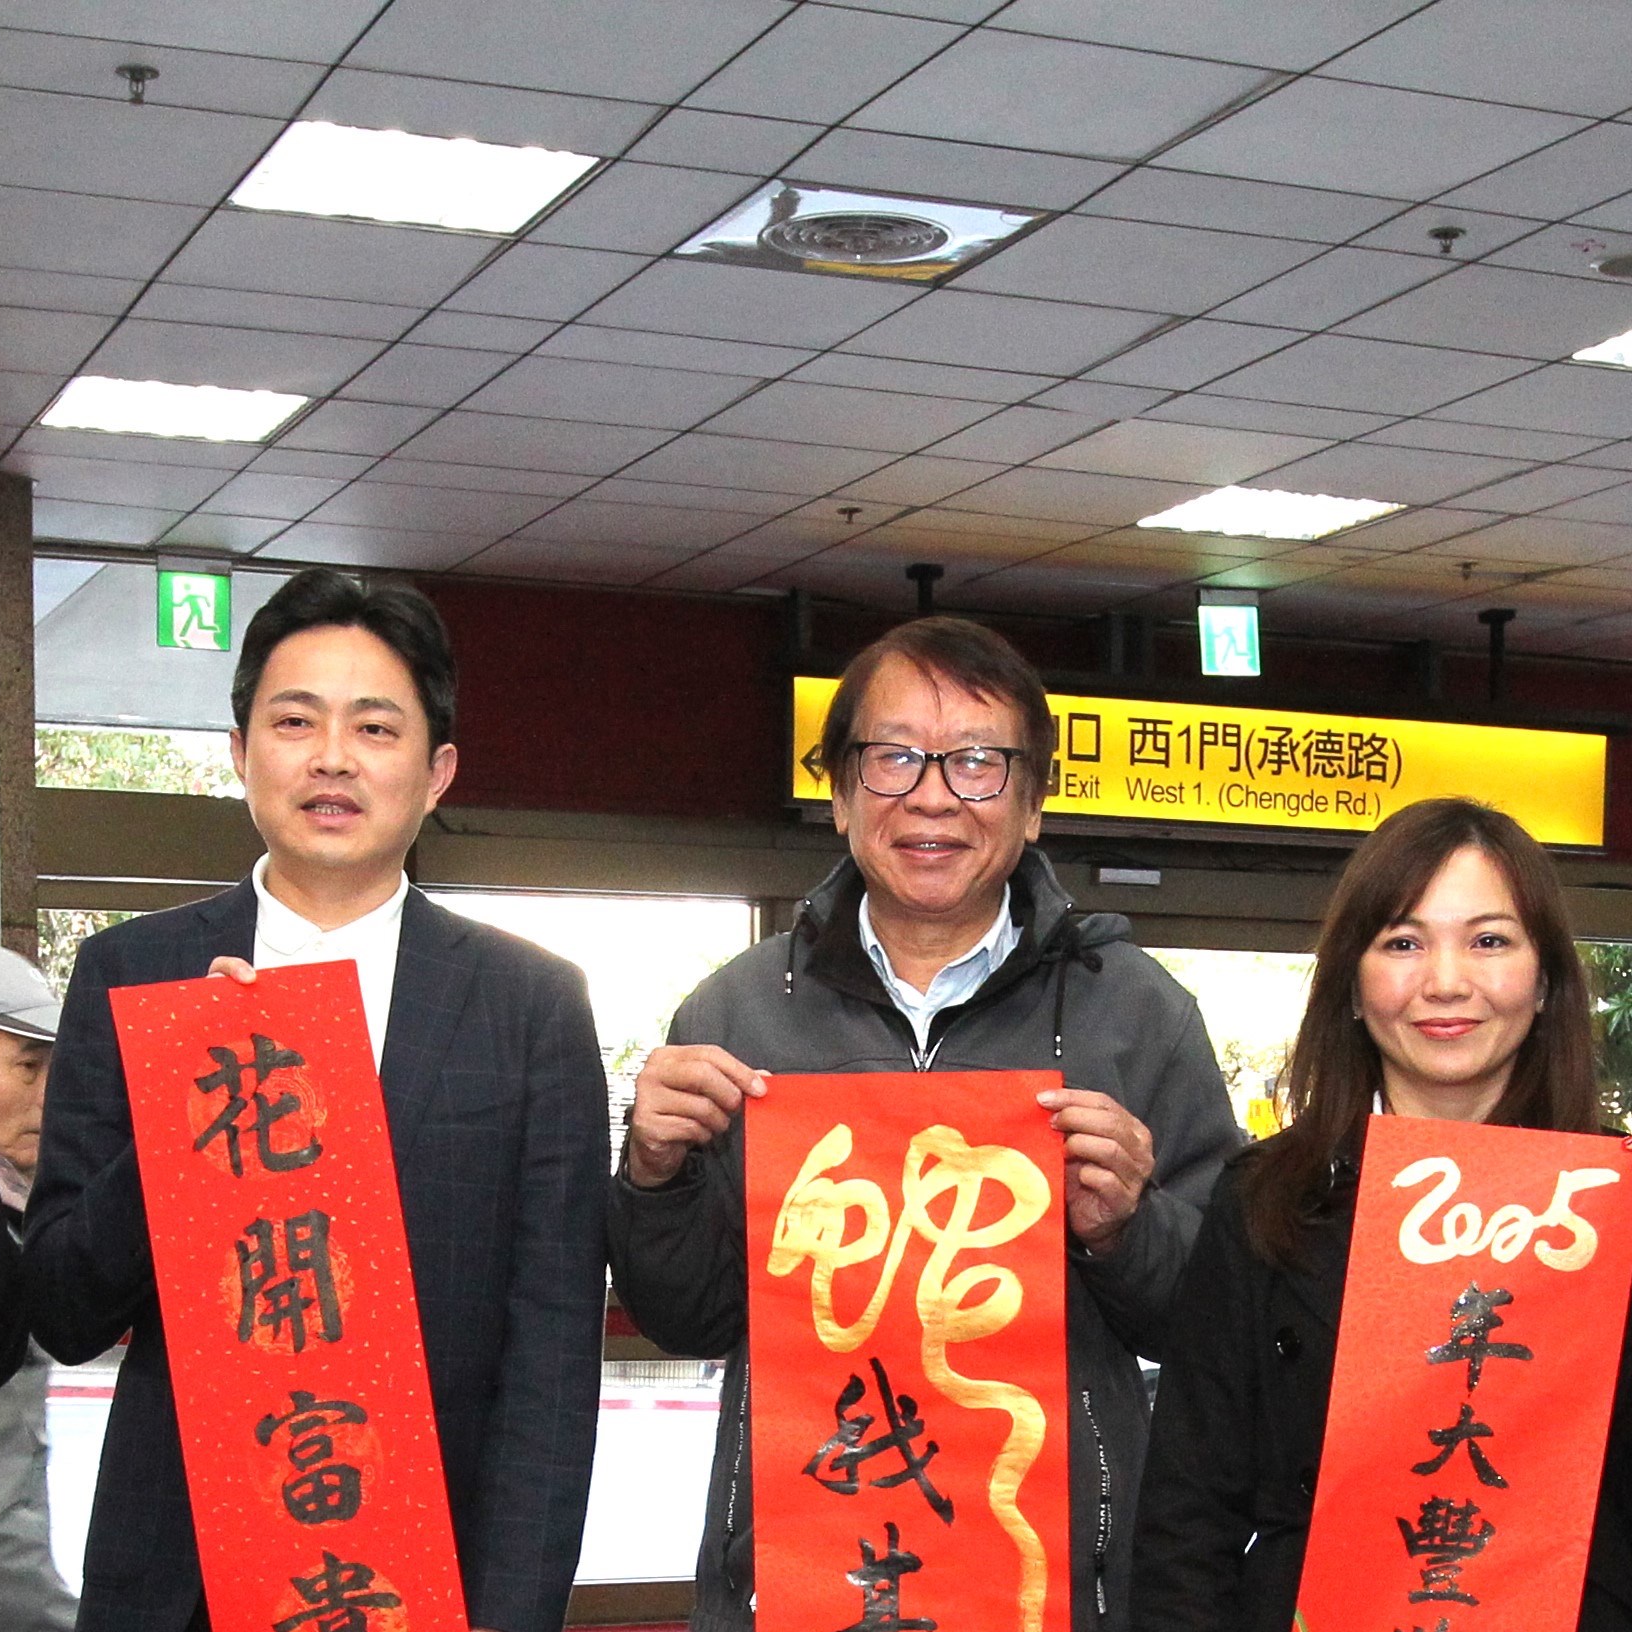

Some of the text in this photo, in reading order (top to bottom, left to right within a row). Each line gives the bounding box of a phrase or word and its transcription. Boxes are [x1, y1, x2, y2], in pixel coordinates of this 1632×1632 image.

[1127, 716, 1402, 788] 西1門(承德路)
[1065, 773, 1101, 799] Exit
[1126, 777, 1185, 804] West
[1219, 783, 1328, 815] (Chengde
[1336, 790, 1382, 820] Rd.)
[1391, 1156, 1621, 1272] 2025
